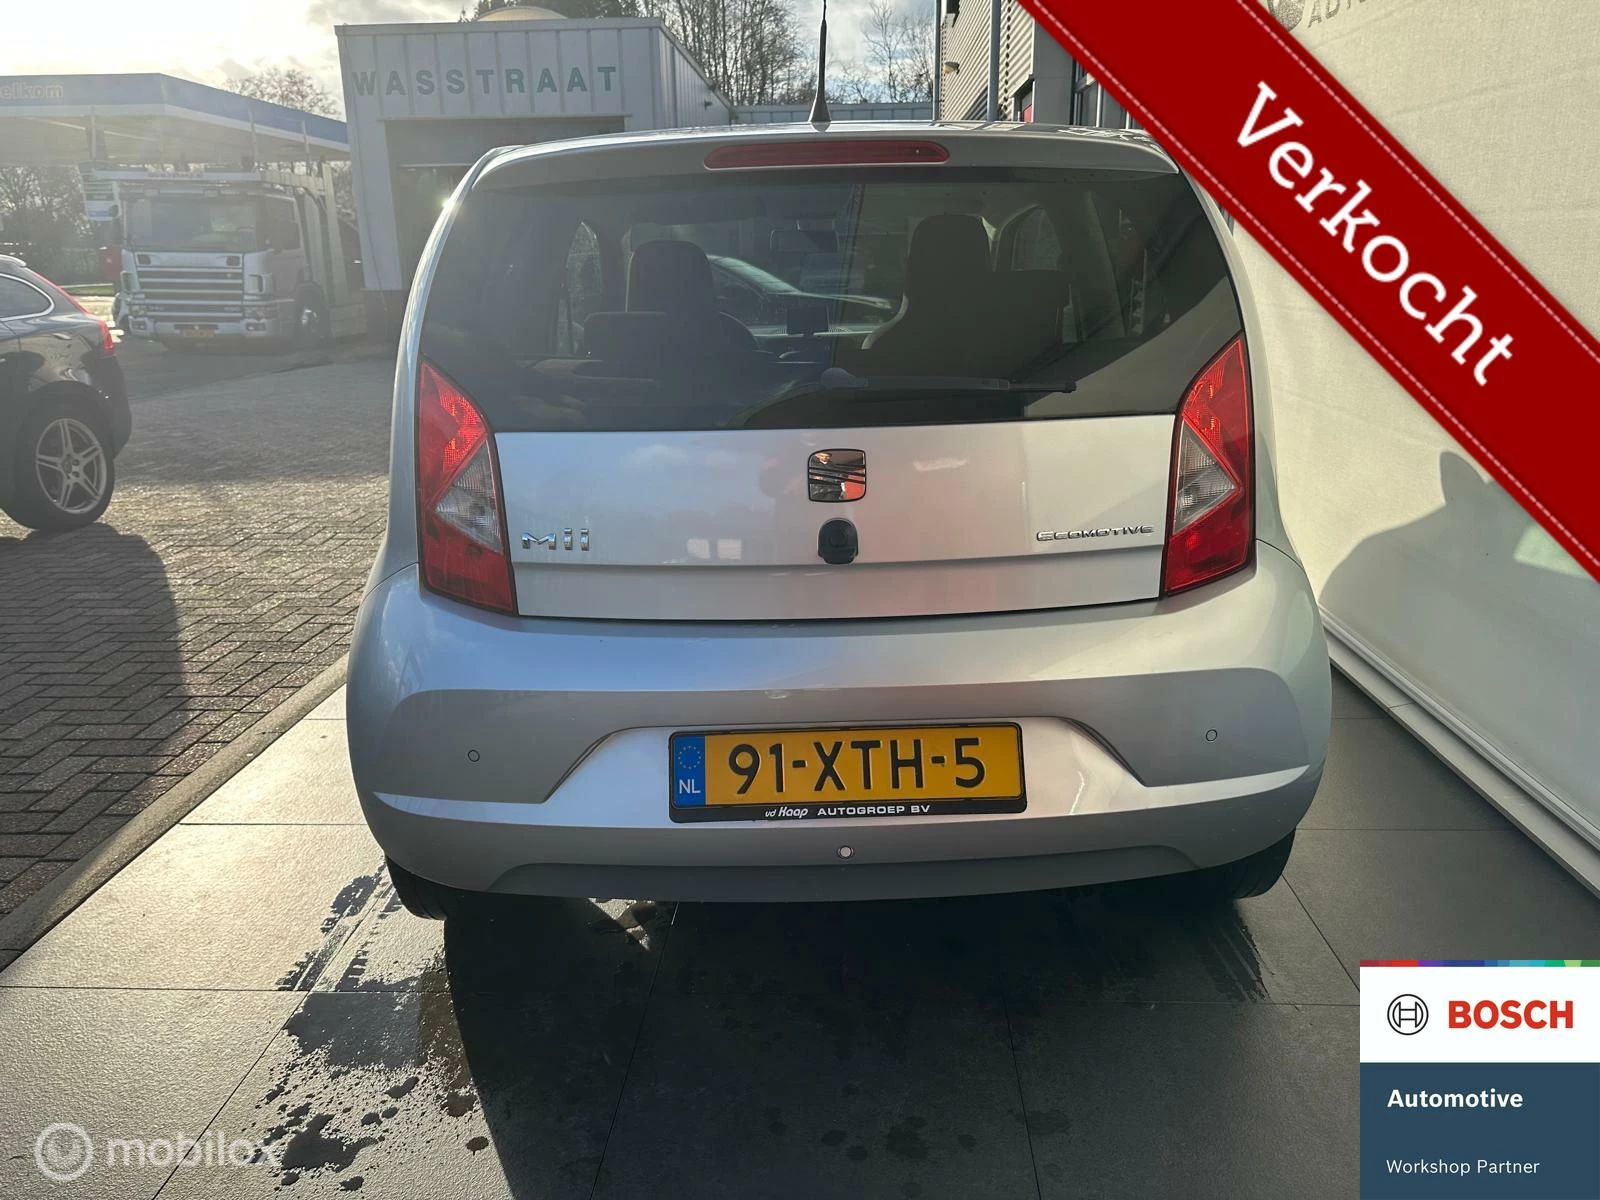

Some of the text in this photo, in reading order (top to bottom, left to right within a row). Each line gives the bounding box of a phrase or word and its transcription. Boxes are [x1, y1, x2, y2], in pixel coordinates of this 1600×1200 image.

[352, 66, 617, 97] WASSTRAAT
[728, 737, 986, 795] 91-XTH-5
[679, 778, 701, 794] NL
[817, 805, 905, 816] AUTOGROEP
[911, 804, 931, 813] BV
